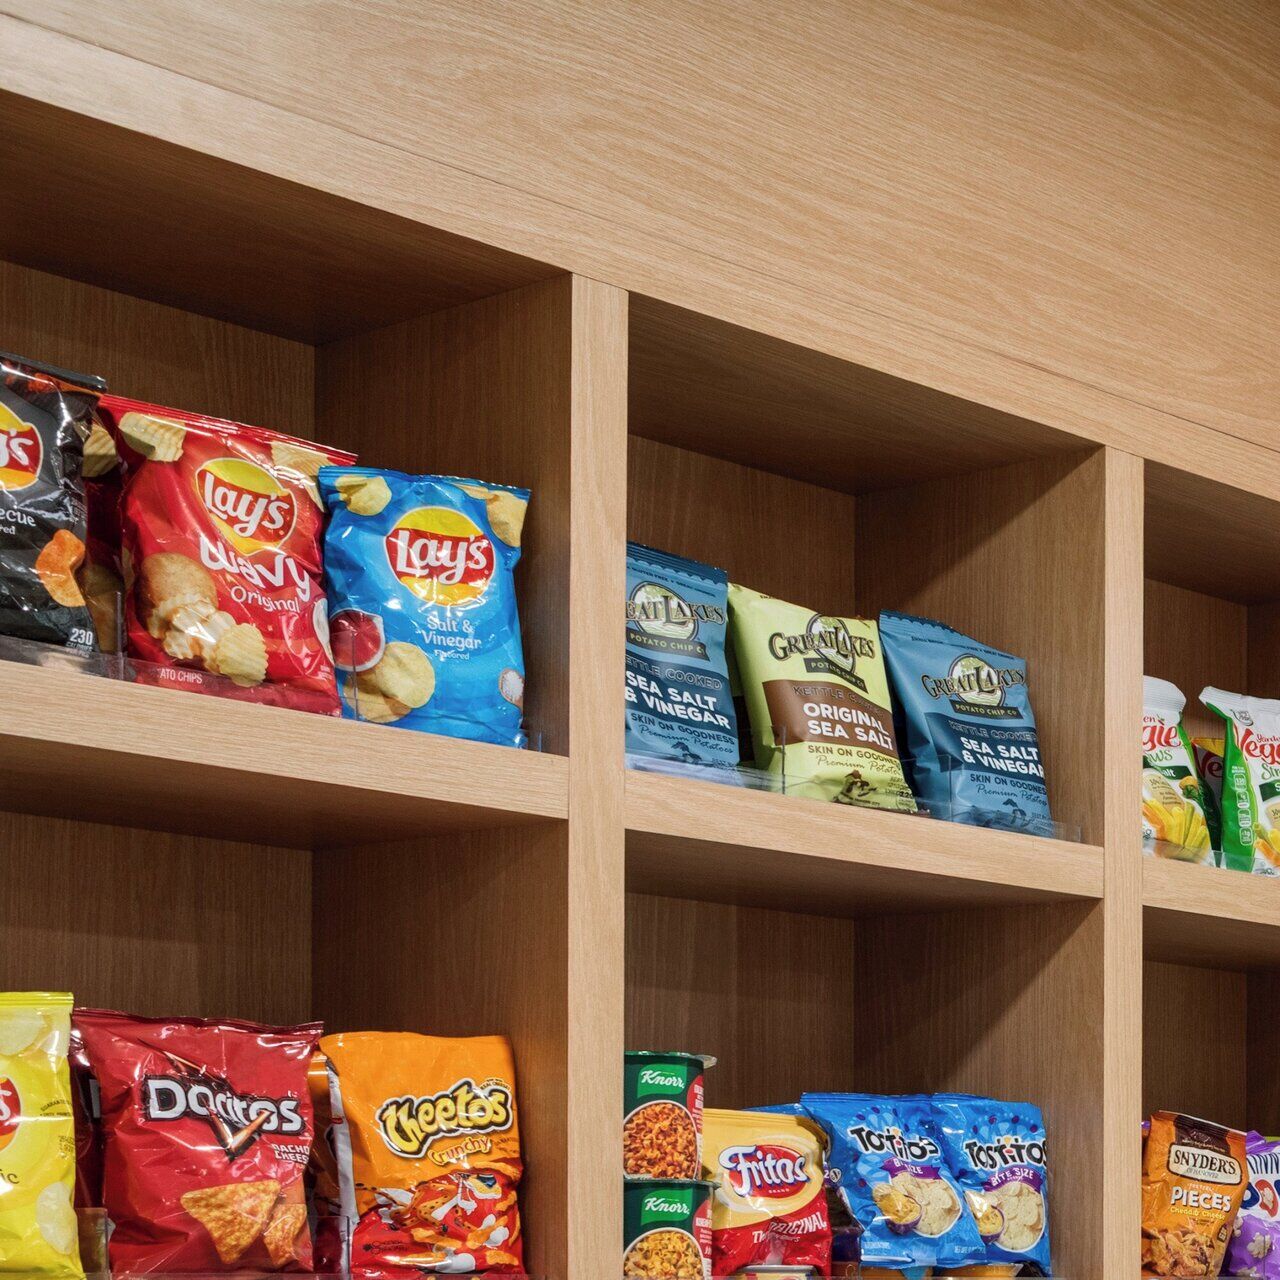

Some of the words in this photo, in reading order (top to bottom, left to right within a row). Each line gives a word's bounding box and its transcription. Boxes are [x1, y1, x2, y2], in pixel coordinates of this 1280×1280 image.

[204, 474, 288, 537] Lay's
[397, 531, 487, 585] Lay's
[231, 585, 300, 613] Original
[70, 628, 93, 645] 230
[427, 616, 459, 632] Salt
[462, 618, 474, 632] &
[421, 630, 482, 650] Vinegar
[630, 634, 666, 648] POTATO
[671, 641, 694, 652] CHIP
[835, 627, 875, 659] LAKES
[626, 671, 662, 697] SEA
[669, 689, 716, 712] SALT
[921, 674, 975, 699] GREAT
[975, 667, 1024, 693] LAKES
[643, 692, 730, 729] VINEGAR
[804, 703, 889, 735] ORIGINAL
[956, 704, 984, 714] POTATO
[808, 721, 849, 738] SEA
[855, 728, 893, 750] SALT
[961, 737, 993, 753] SEA
[998, 745, 1037, 761] SALT
[640, 1070, 684, 1089] Knorr
[147, 1078, 305, 1133] Doritos
[382, 1085, 507, 1153] Cheetos
[272, 1144, 310, 1155] NACHO
[428, 1136, 491, 1164] Crunchy
[1174, 1150, 1236, 1174] SNYDER'S
[719, 1145, 810, 1196] Fritos
[992, 1171, 1012, 1186] BITE
[1015, 1168, 1034, 1179] SIZE
[645, 1196, 689, 1214] Knorr
[1170, 1186, 1232, 1212] PIECES
